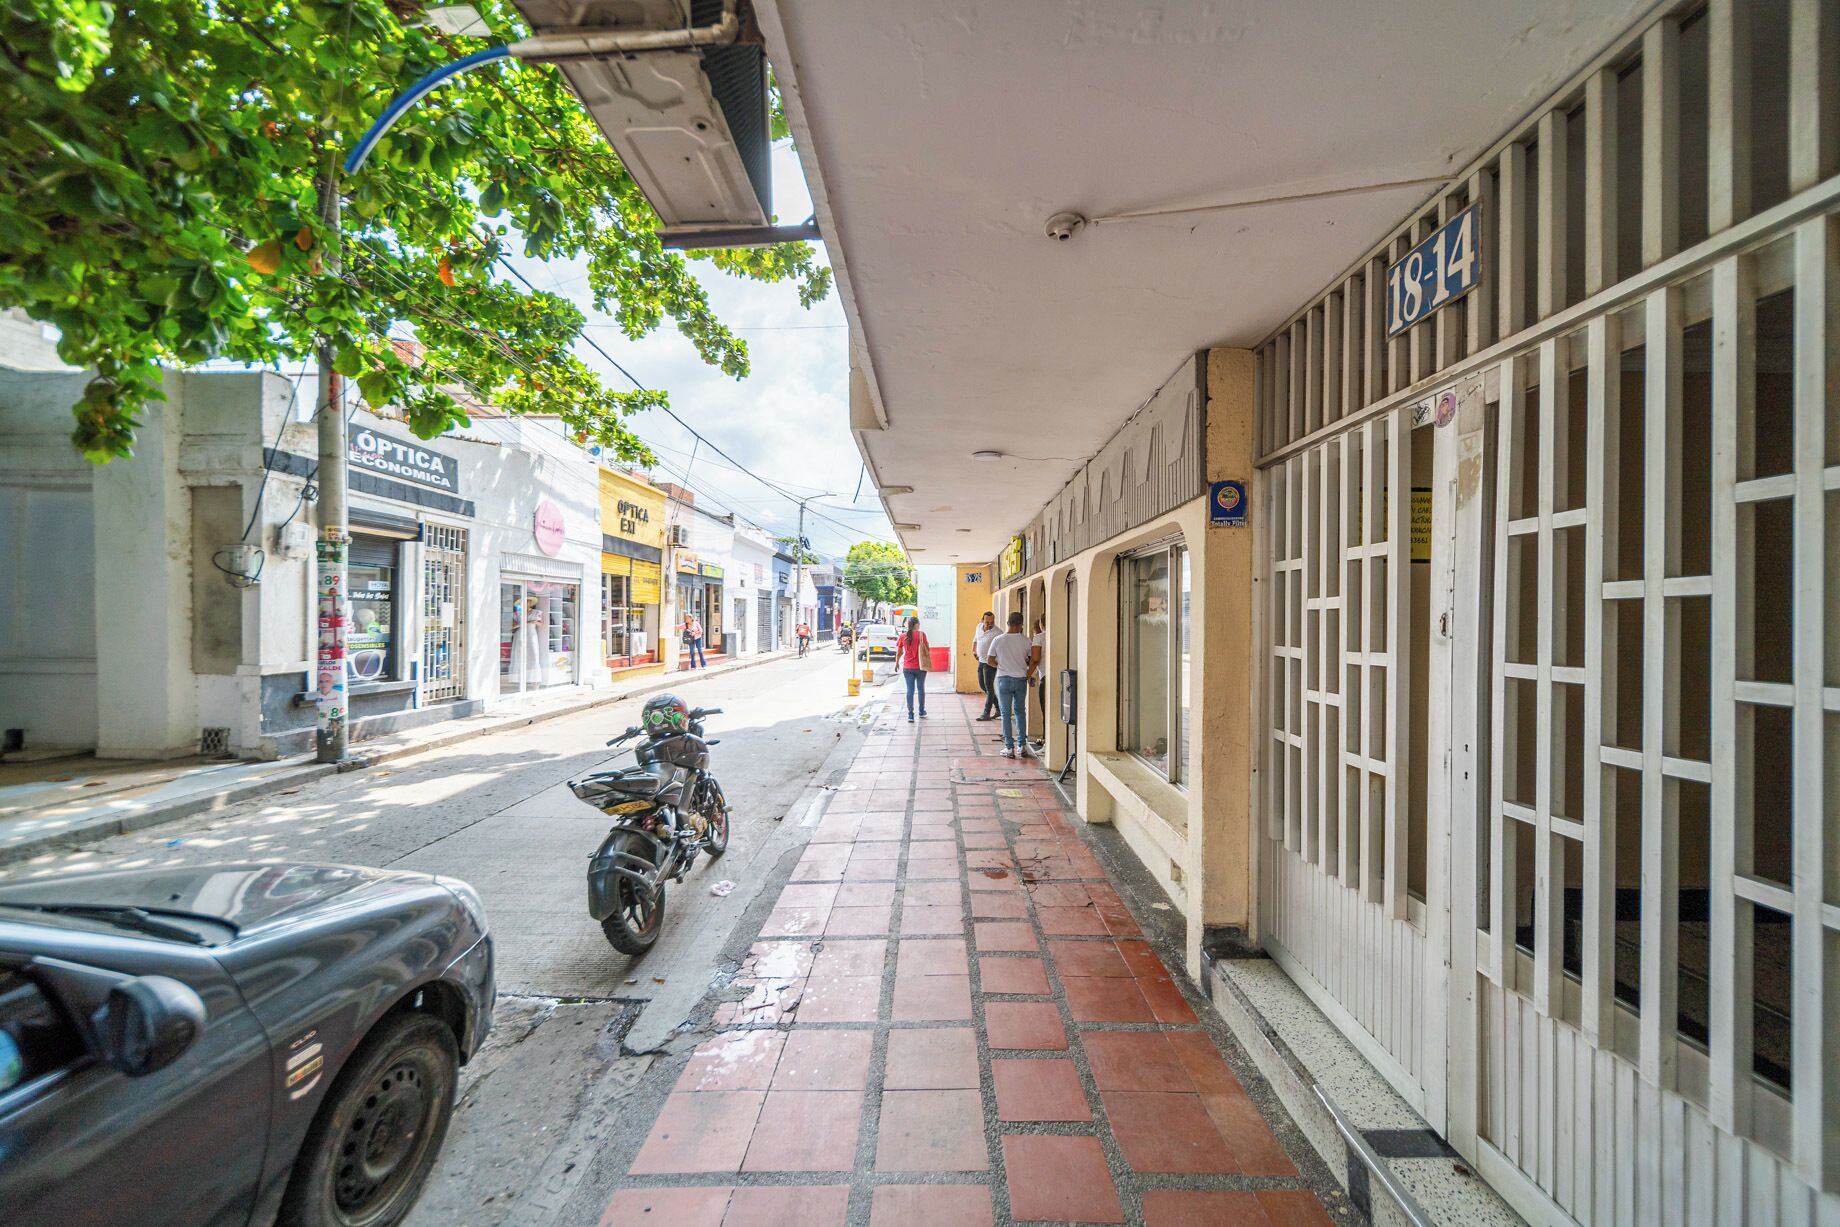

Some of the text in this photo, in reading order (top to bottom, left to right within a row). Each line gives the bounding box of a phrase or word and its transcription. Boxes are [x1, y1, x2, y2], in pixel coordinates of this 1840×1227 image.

[1389, 211, 1475, 334] 18-14
[349, 450, 451, 488] ECONOMICA
[356, 430, 445, 474] ÓPTICA
[617, 499, 649, 523] OPTICA
[620, 517, 635, 534] EXI
